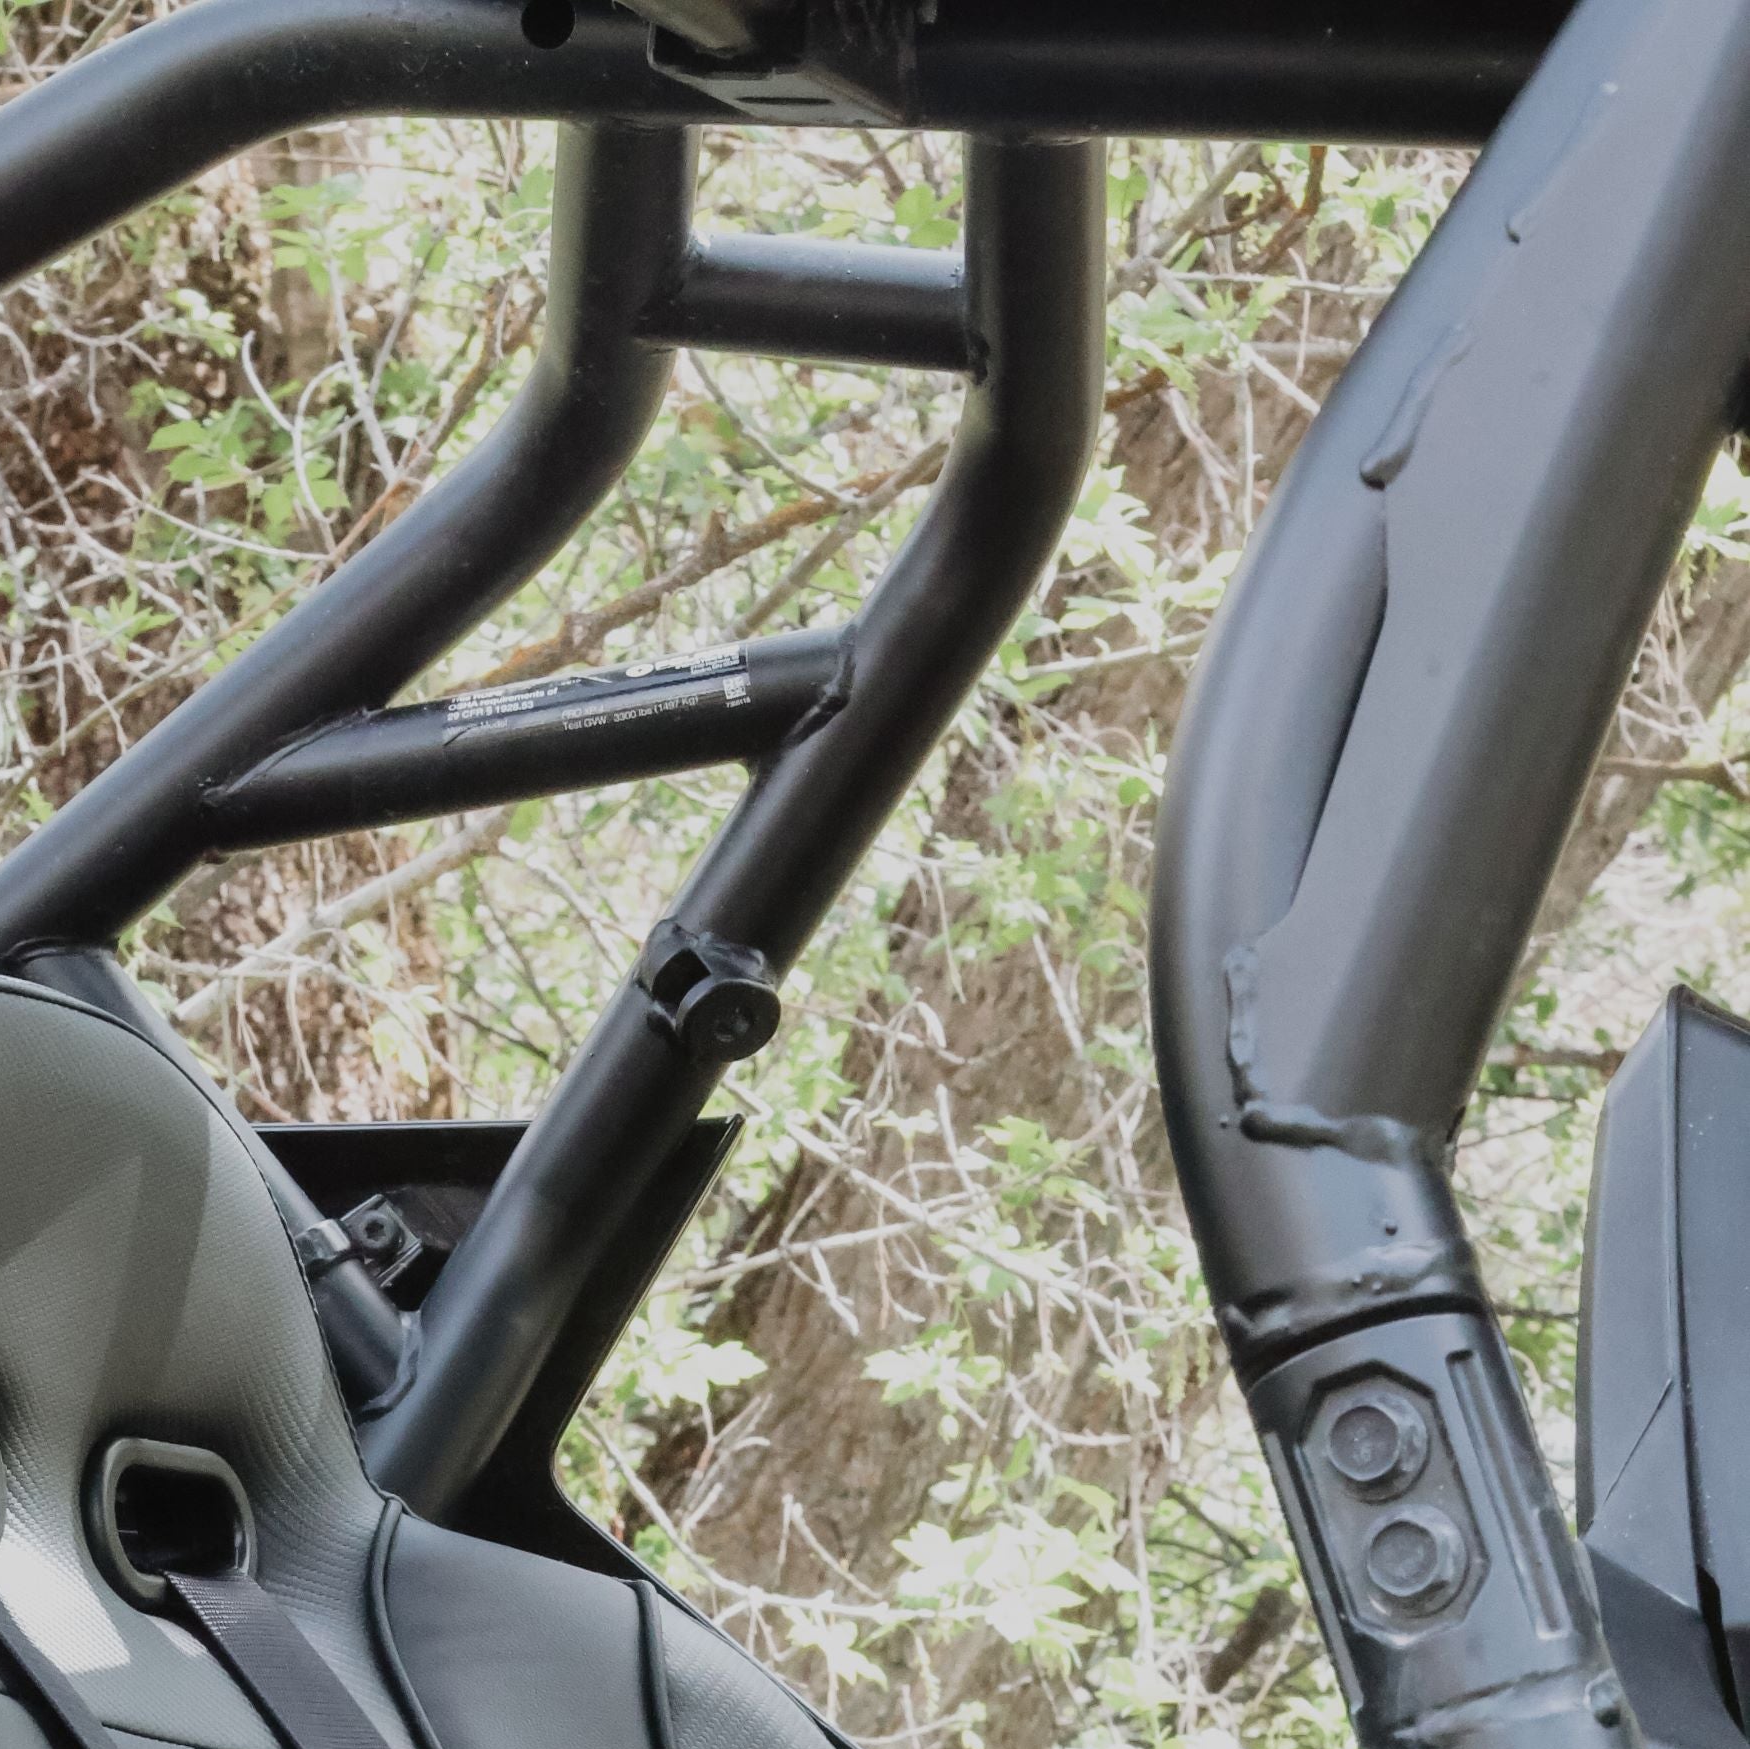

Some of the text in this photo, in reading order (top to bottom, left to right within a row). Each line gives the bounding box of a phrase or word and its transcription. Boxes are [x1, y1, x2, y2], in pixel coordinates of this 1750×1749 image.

[480, 690, 545, 706] requirements
[563, 720, 582, 730] Test
[613, 710, 637, 722] 3300
[638, 708, 653, 717] lbs
